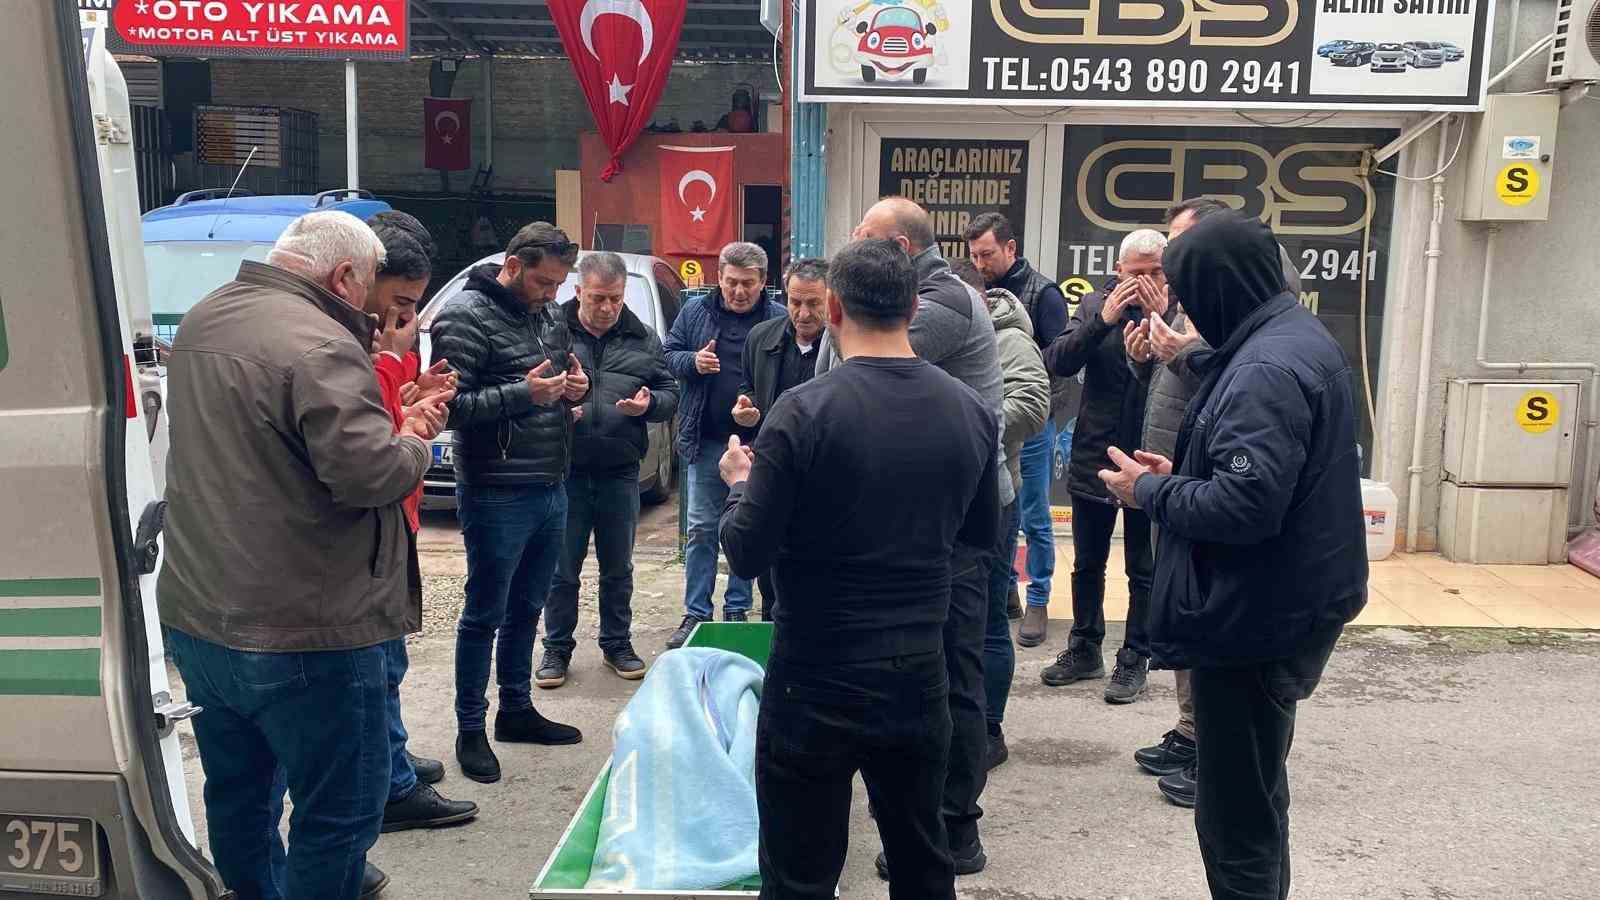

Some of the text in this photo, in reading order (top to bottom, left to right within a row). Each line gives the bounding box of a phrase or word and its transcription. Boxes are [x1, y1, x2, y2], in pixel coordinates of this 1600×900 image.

[244, 1, 391, 25] YIKAMA
[221, 29, 258, 42] ALT
[266, 27, 307, 43] ÜST
[315, 31, 398, 45] YIKAMA
[982, 57, 1300, 94] TEL:0543 890 2941
[891, 147, 1023, 177] ARAÇLARINIZ
[1506, 168, 1529, 192] S
[1526, 396, 1549, 421] S
[6, 819, 84, 873] 375
